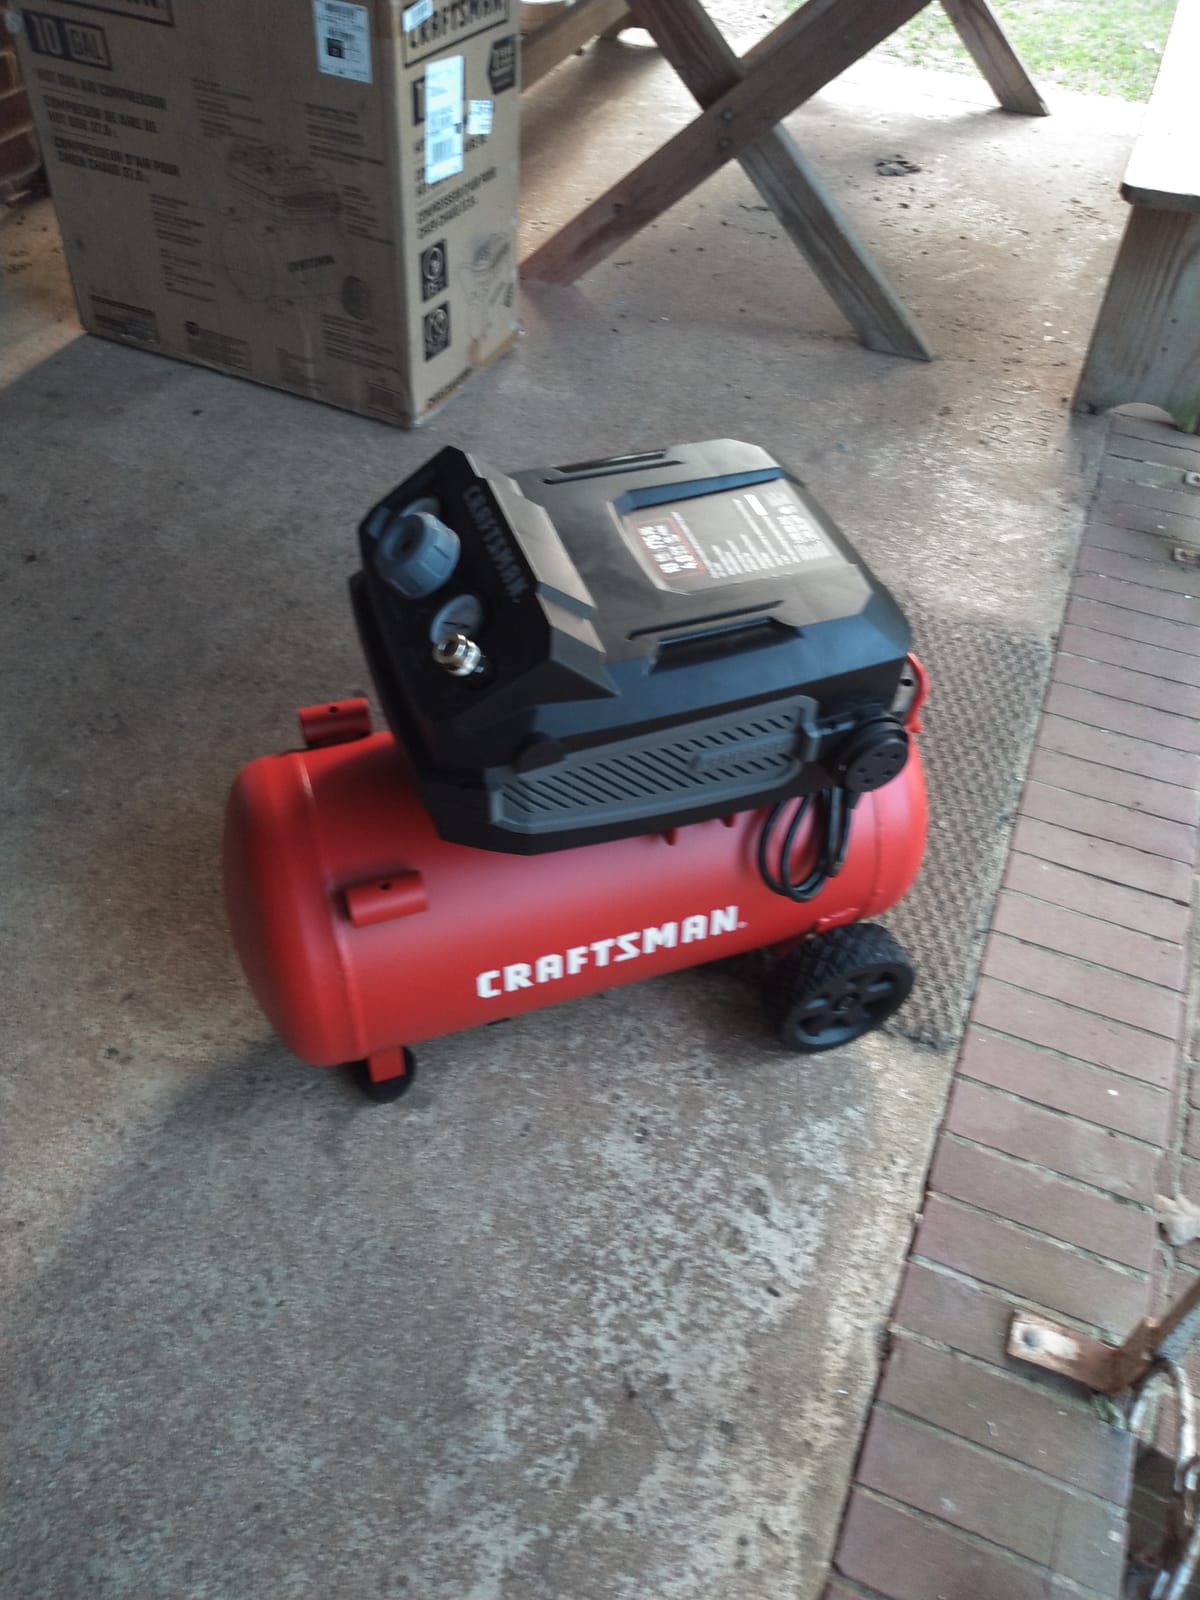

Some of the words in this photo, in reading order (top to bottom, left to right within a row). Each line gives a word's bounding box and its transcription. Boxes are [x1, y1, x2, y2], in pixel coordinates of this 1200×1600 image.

[30, 13, 64, 55] 10
[71, 27, 104, 61] GAL
[462, 485, 529, 602] CRAFTSMAN
[476, 905, 740, 998] CRAFTSMAN
